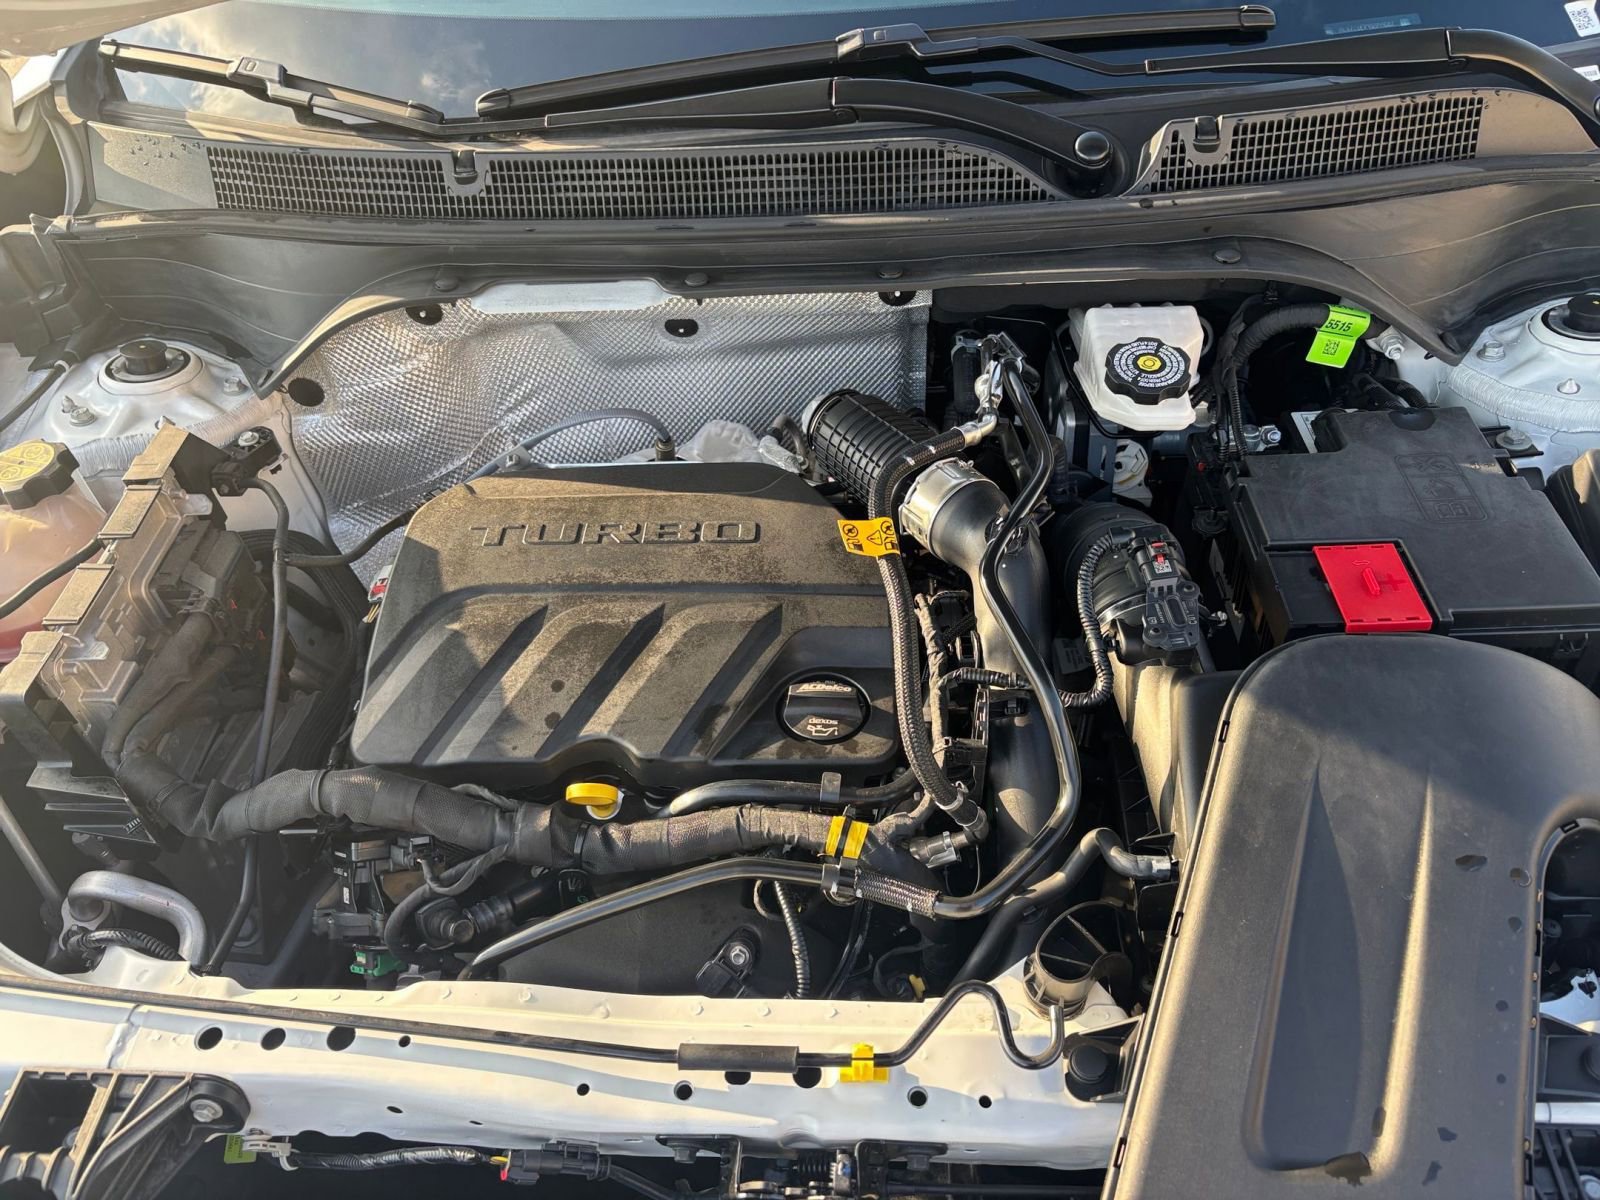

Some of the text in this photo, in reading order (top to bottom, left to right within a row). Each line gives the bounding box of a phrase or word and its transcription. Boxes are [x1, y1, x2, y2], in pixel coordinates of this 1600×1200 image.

[1325, 319, 1353, 332] 5515
[469, 521, 760, 547] TURBO
[797, 683, 852, 693] ACDelco
[808, 717, 839, 725] dexos
